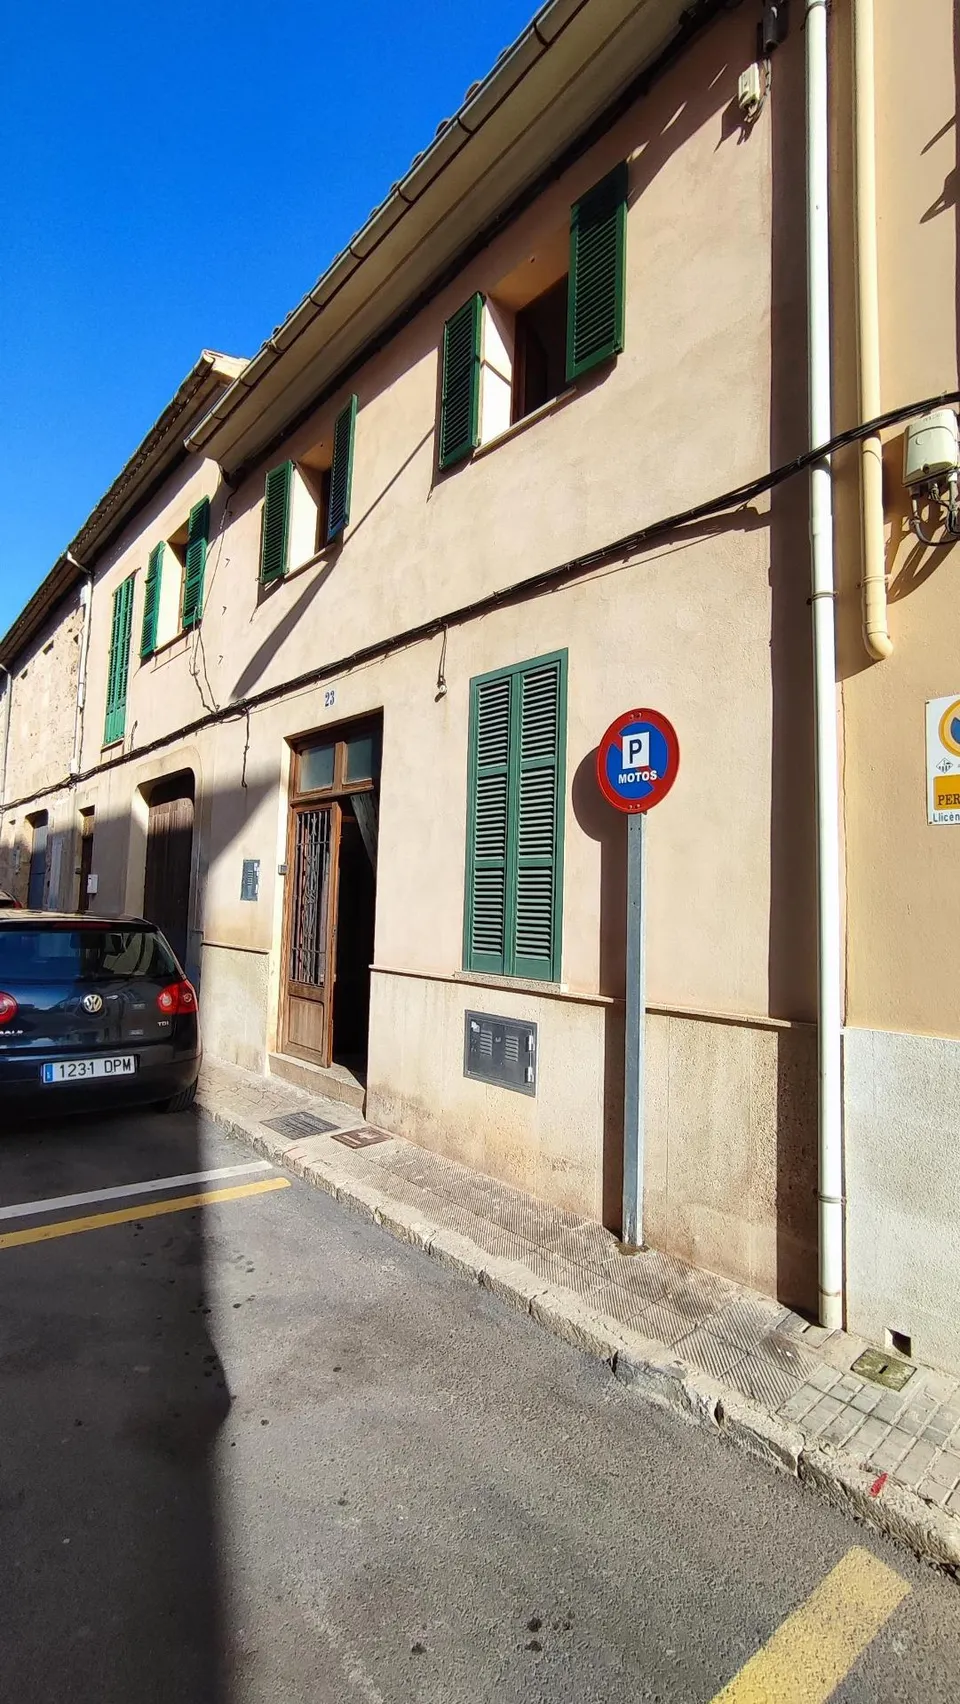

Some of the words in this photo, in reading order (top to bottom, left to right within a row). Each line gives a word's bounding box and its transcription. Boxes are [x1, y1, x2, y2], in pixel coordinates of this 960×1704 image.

[324, 690, 335, 707] 23
[629, 738, 643, 764] P
[618, 769, 658, 784] MOTOS
[59, 1061, 95, 1078] 1231
[104, 1057, 131, 1074] DPM
